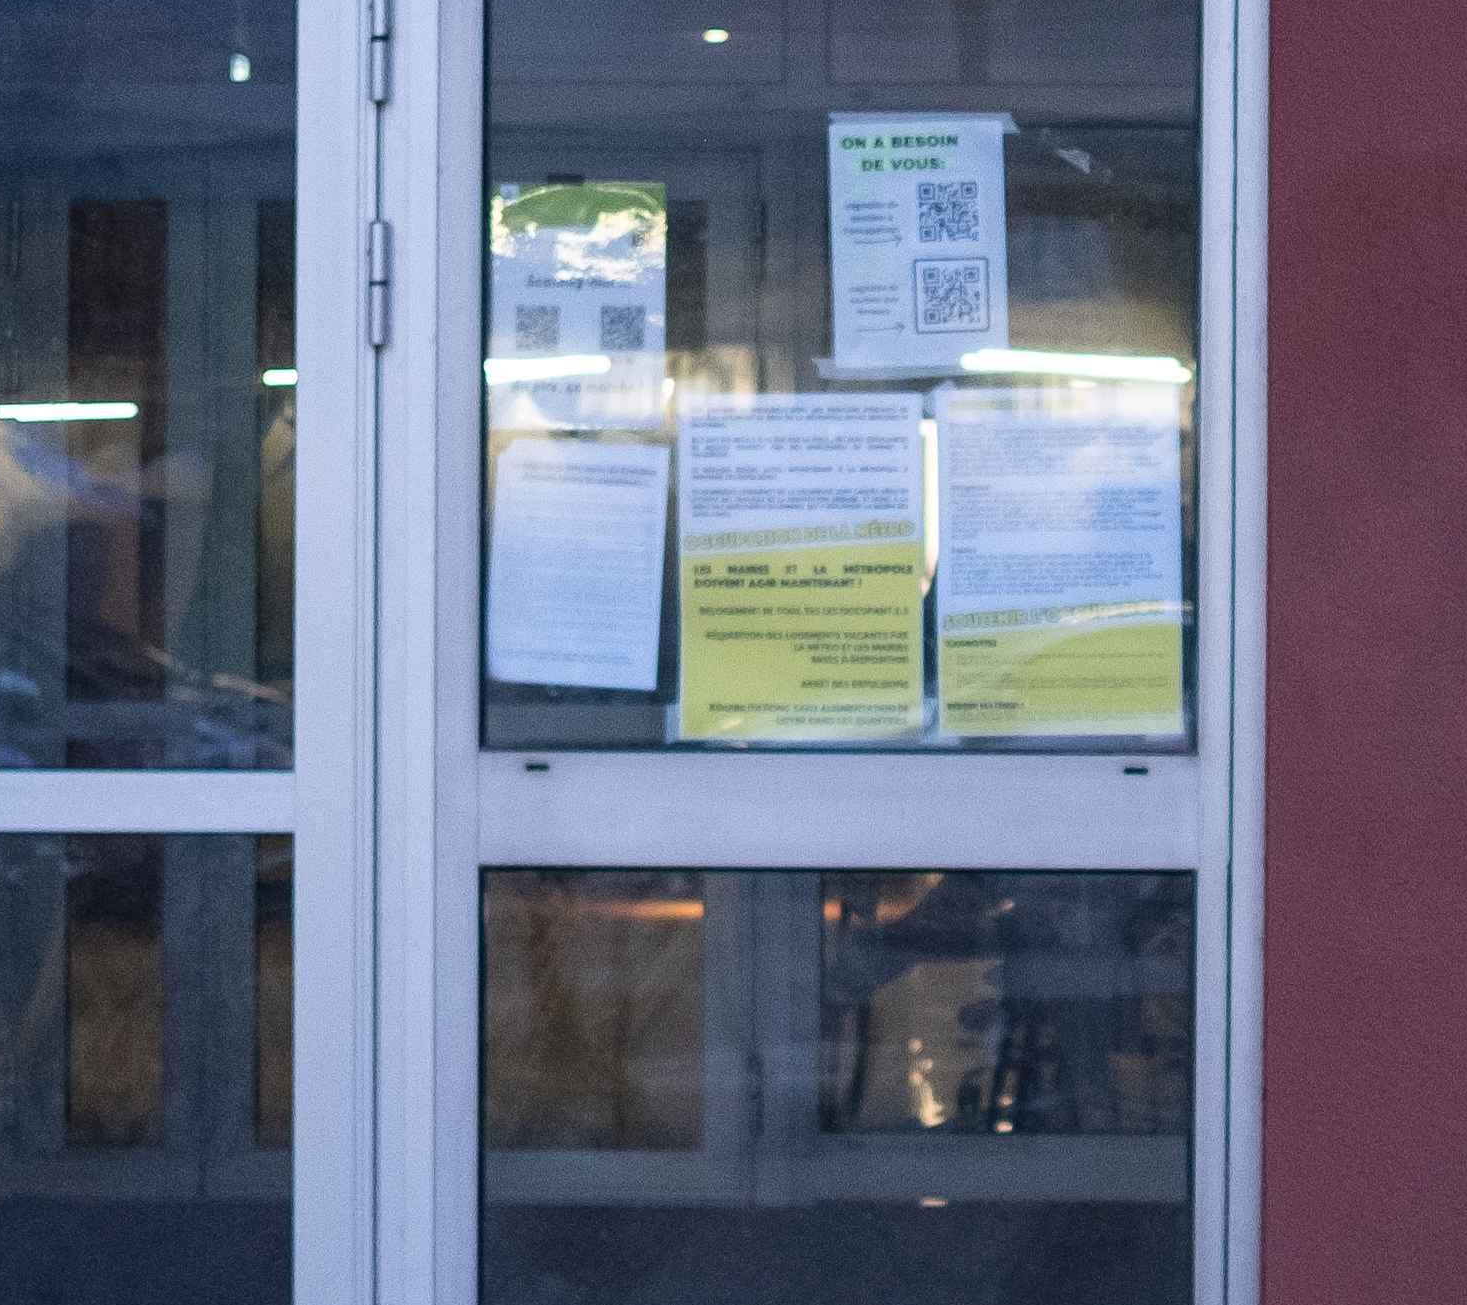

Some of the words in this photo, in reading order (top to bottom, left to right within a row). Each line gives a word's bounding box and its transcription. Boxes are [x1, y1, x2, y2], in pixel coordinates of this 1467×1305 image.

[841, 137, 867, 150] ON
[873, 136, 885, 149] A
[891, 135, 959, 149] BESOIN
[861, 158, 885, 172] DE
